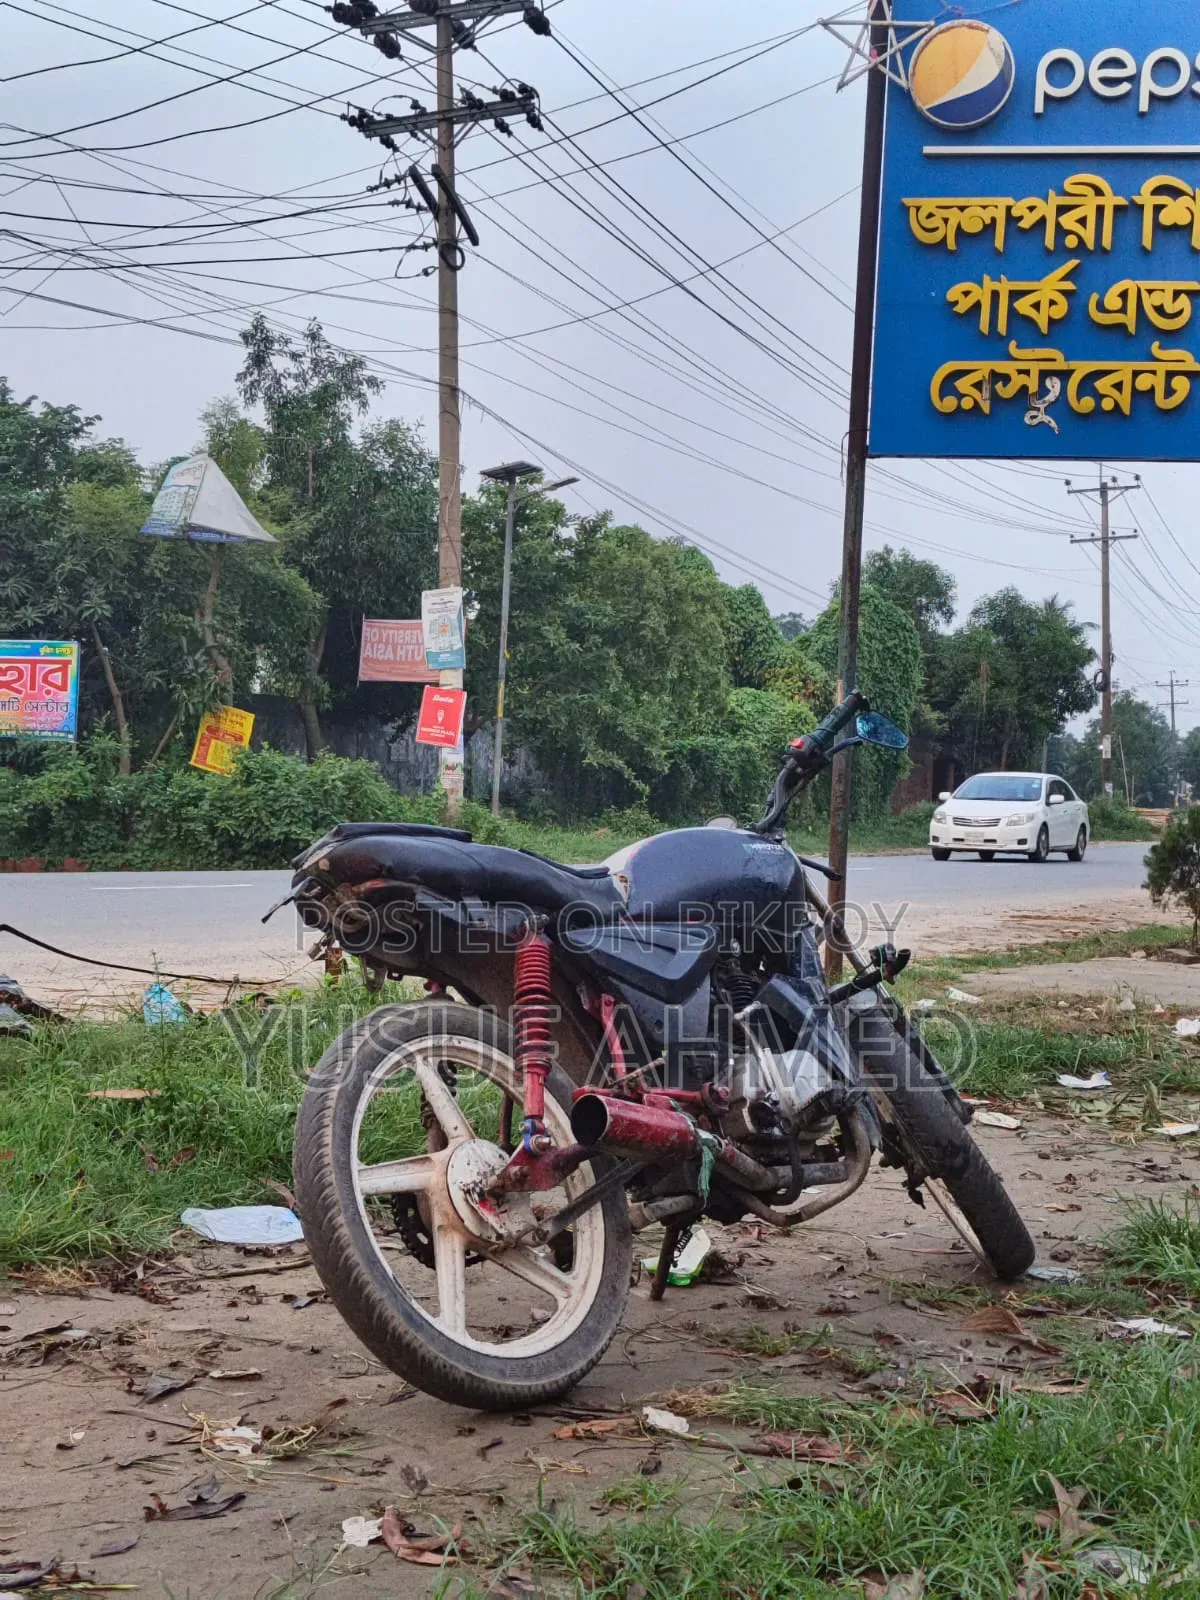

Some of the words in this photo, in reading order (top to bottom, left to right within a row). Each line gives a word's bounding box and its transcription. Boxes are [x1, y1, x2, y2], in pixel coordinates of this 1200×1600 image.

[1034, 47, 1200, 113] pep
[901, 173, 1128, 252] জলপরী
[946, 259, 1080, 335] পার্ক
[1088, 279, 1200, 335] এন্ড
[930, 340, 1200, 434] রেস্টুরেন্ট
[24, 699, 69, 712] সেন্টার
